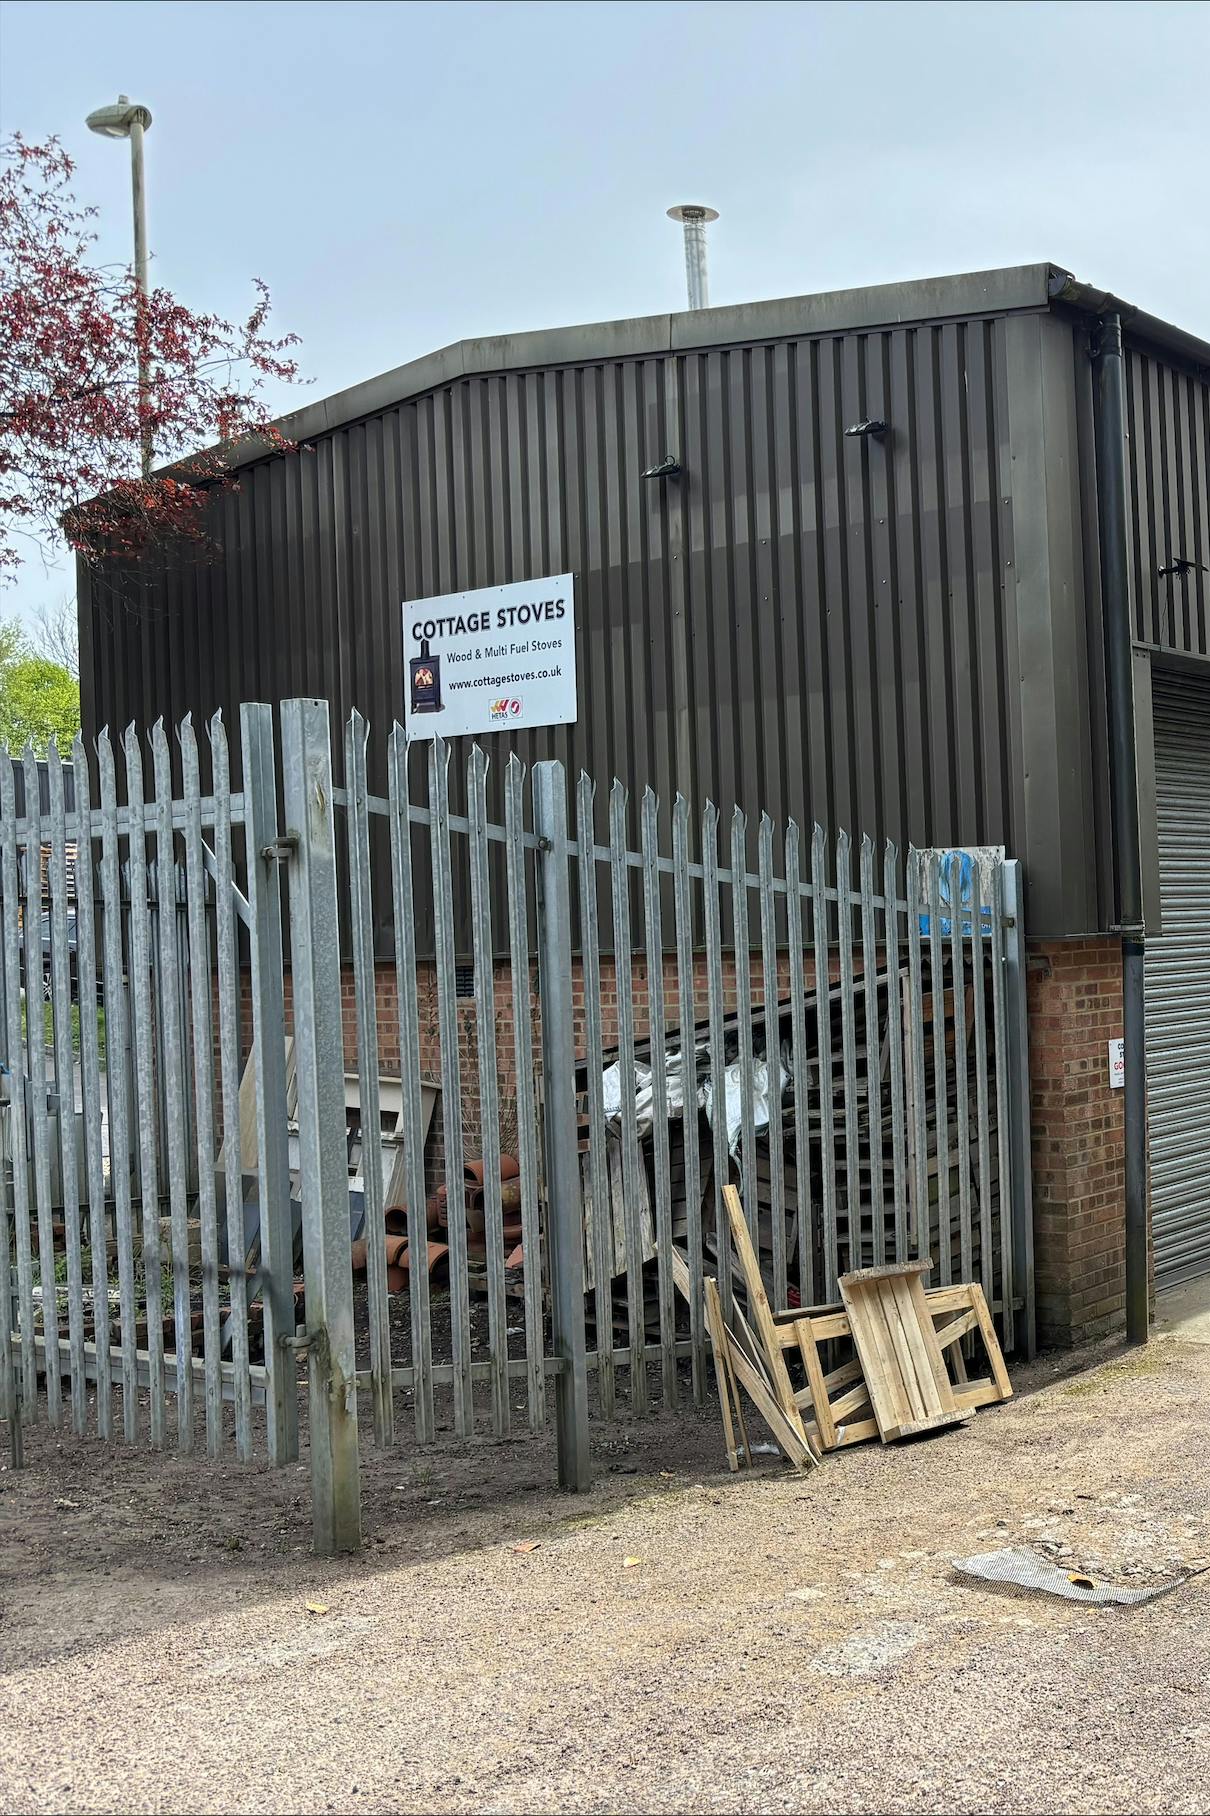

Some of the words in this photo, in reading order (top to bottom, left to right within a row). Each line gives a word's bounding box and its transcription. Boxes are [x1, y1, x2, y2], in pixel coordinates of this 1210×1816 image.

[412, 611, 490, 641] COTTAGE
[497, 599, 566, 628] STOVES
[446, 650, 472, 663] Wood
[475, 650, 482, 660] &
[484, 644, 508, 658] Multi
[510, 641, 529, 654] Fuel
[531, 638, 562, 652] Stoves
[448, 665, 562, 691] www.cottagestoves.co.uk
[491, 711, 508, 720] HETAS
